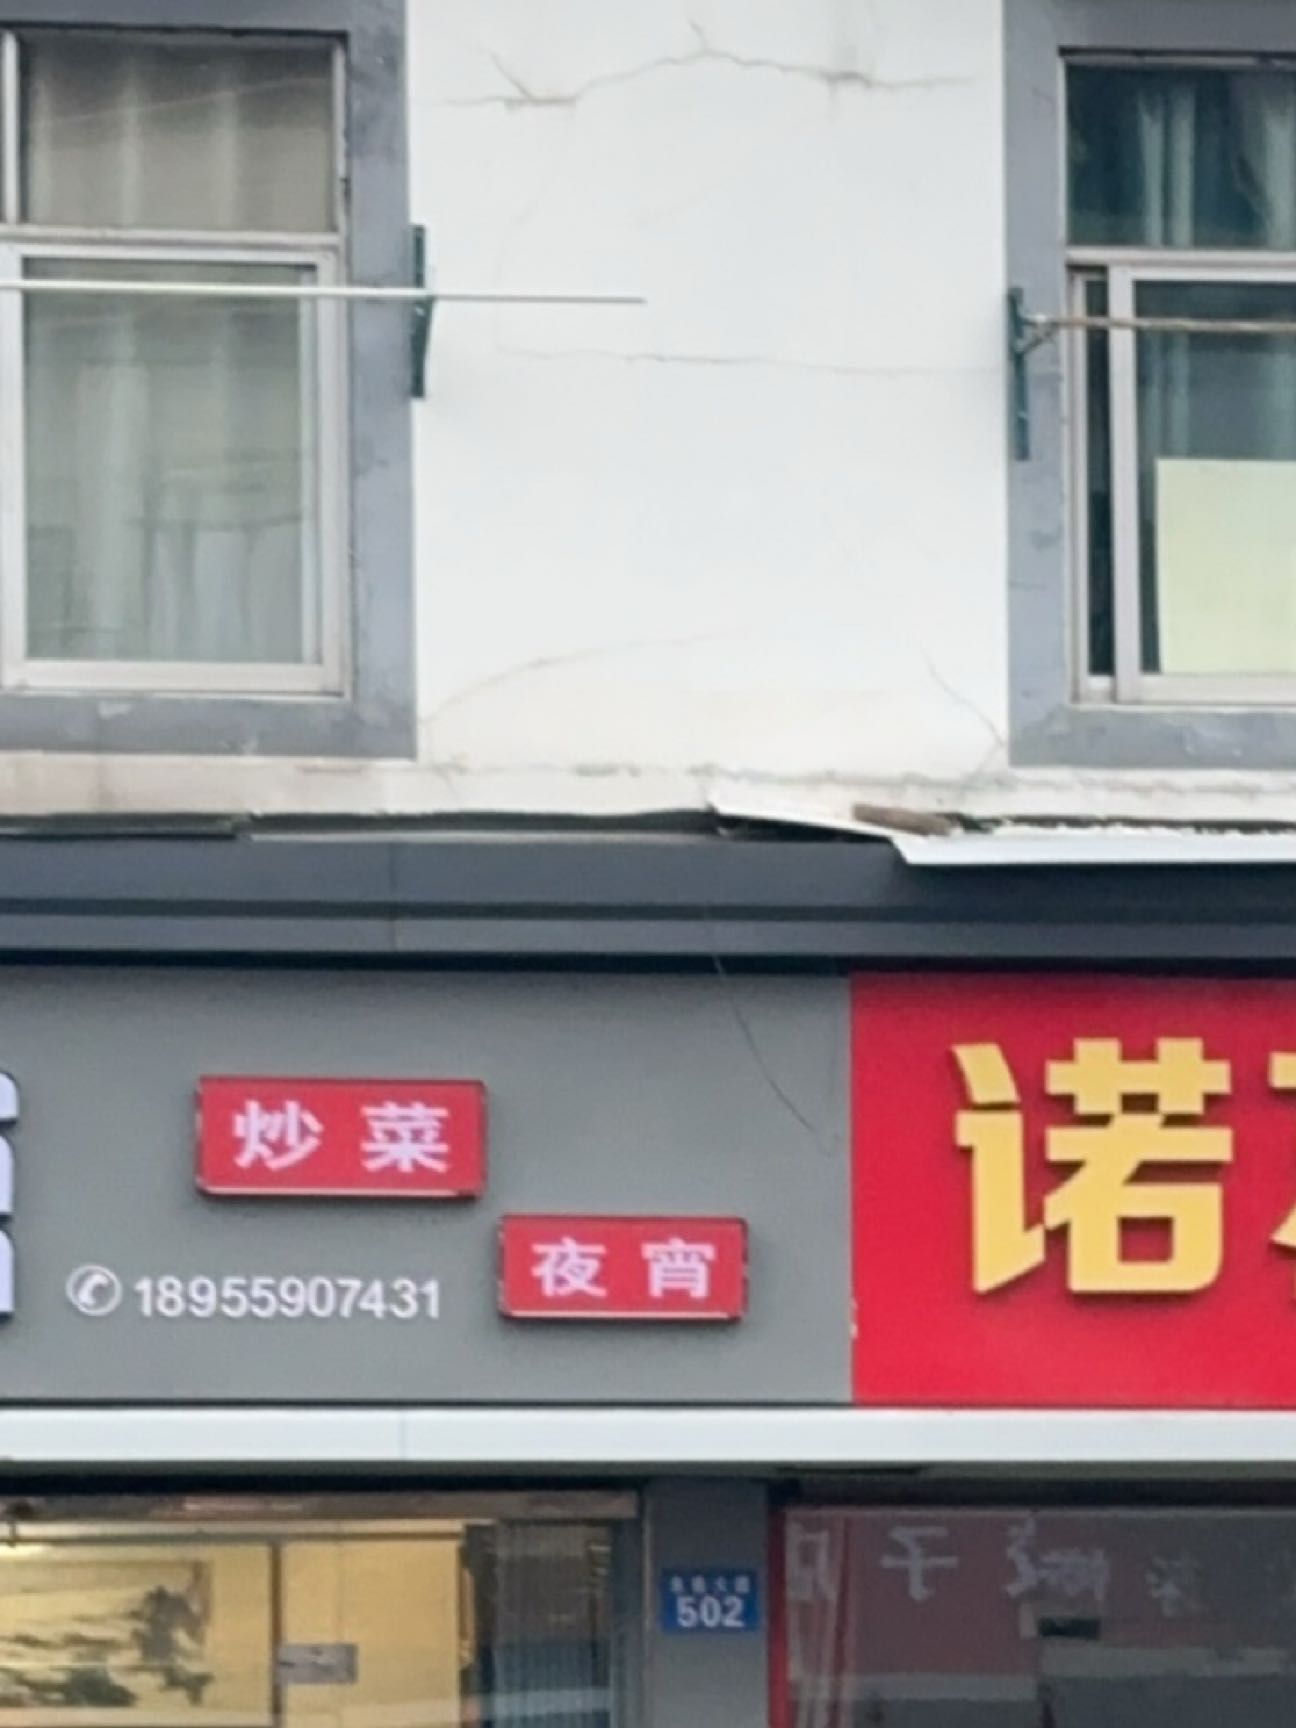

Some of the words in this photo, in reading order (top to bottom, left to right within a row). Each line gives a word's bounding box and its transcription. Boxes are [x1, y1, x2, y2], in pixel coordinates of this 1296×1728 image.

[232, 1100, 450, 1174] 炒菜
[532, 1237, 716, 1298] 夜宵
[134, 1275, 440, 1318] 18955907431
[677, 1595, 745, 1628] 502
